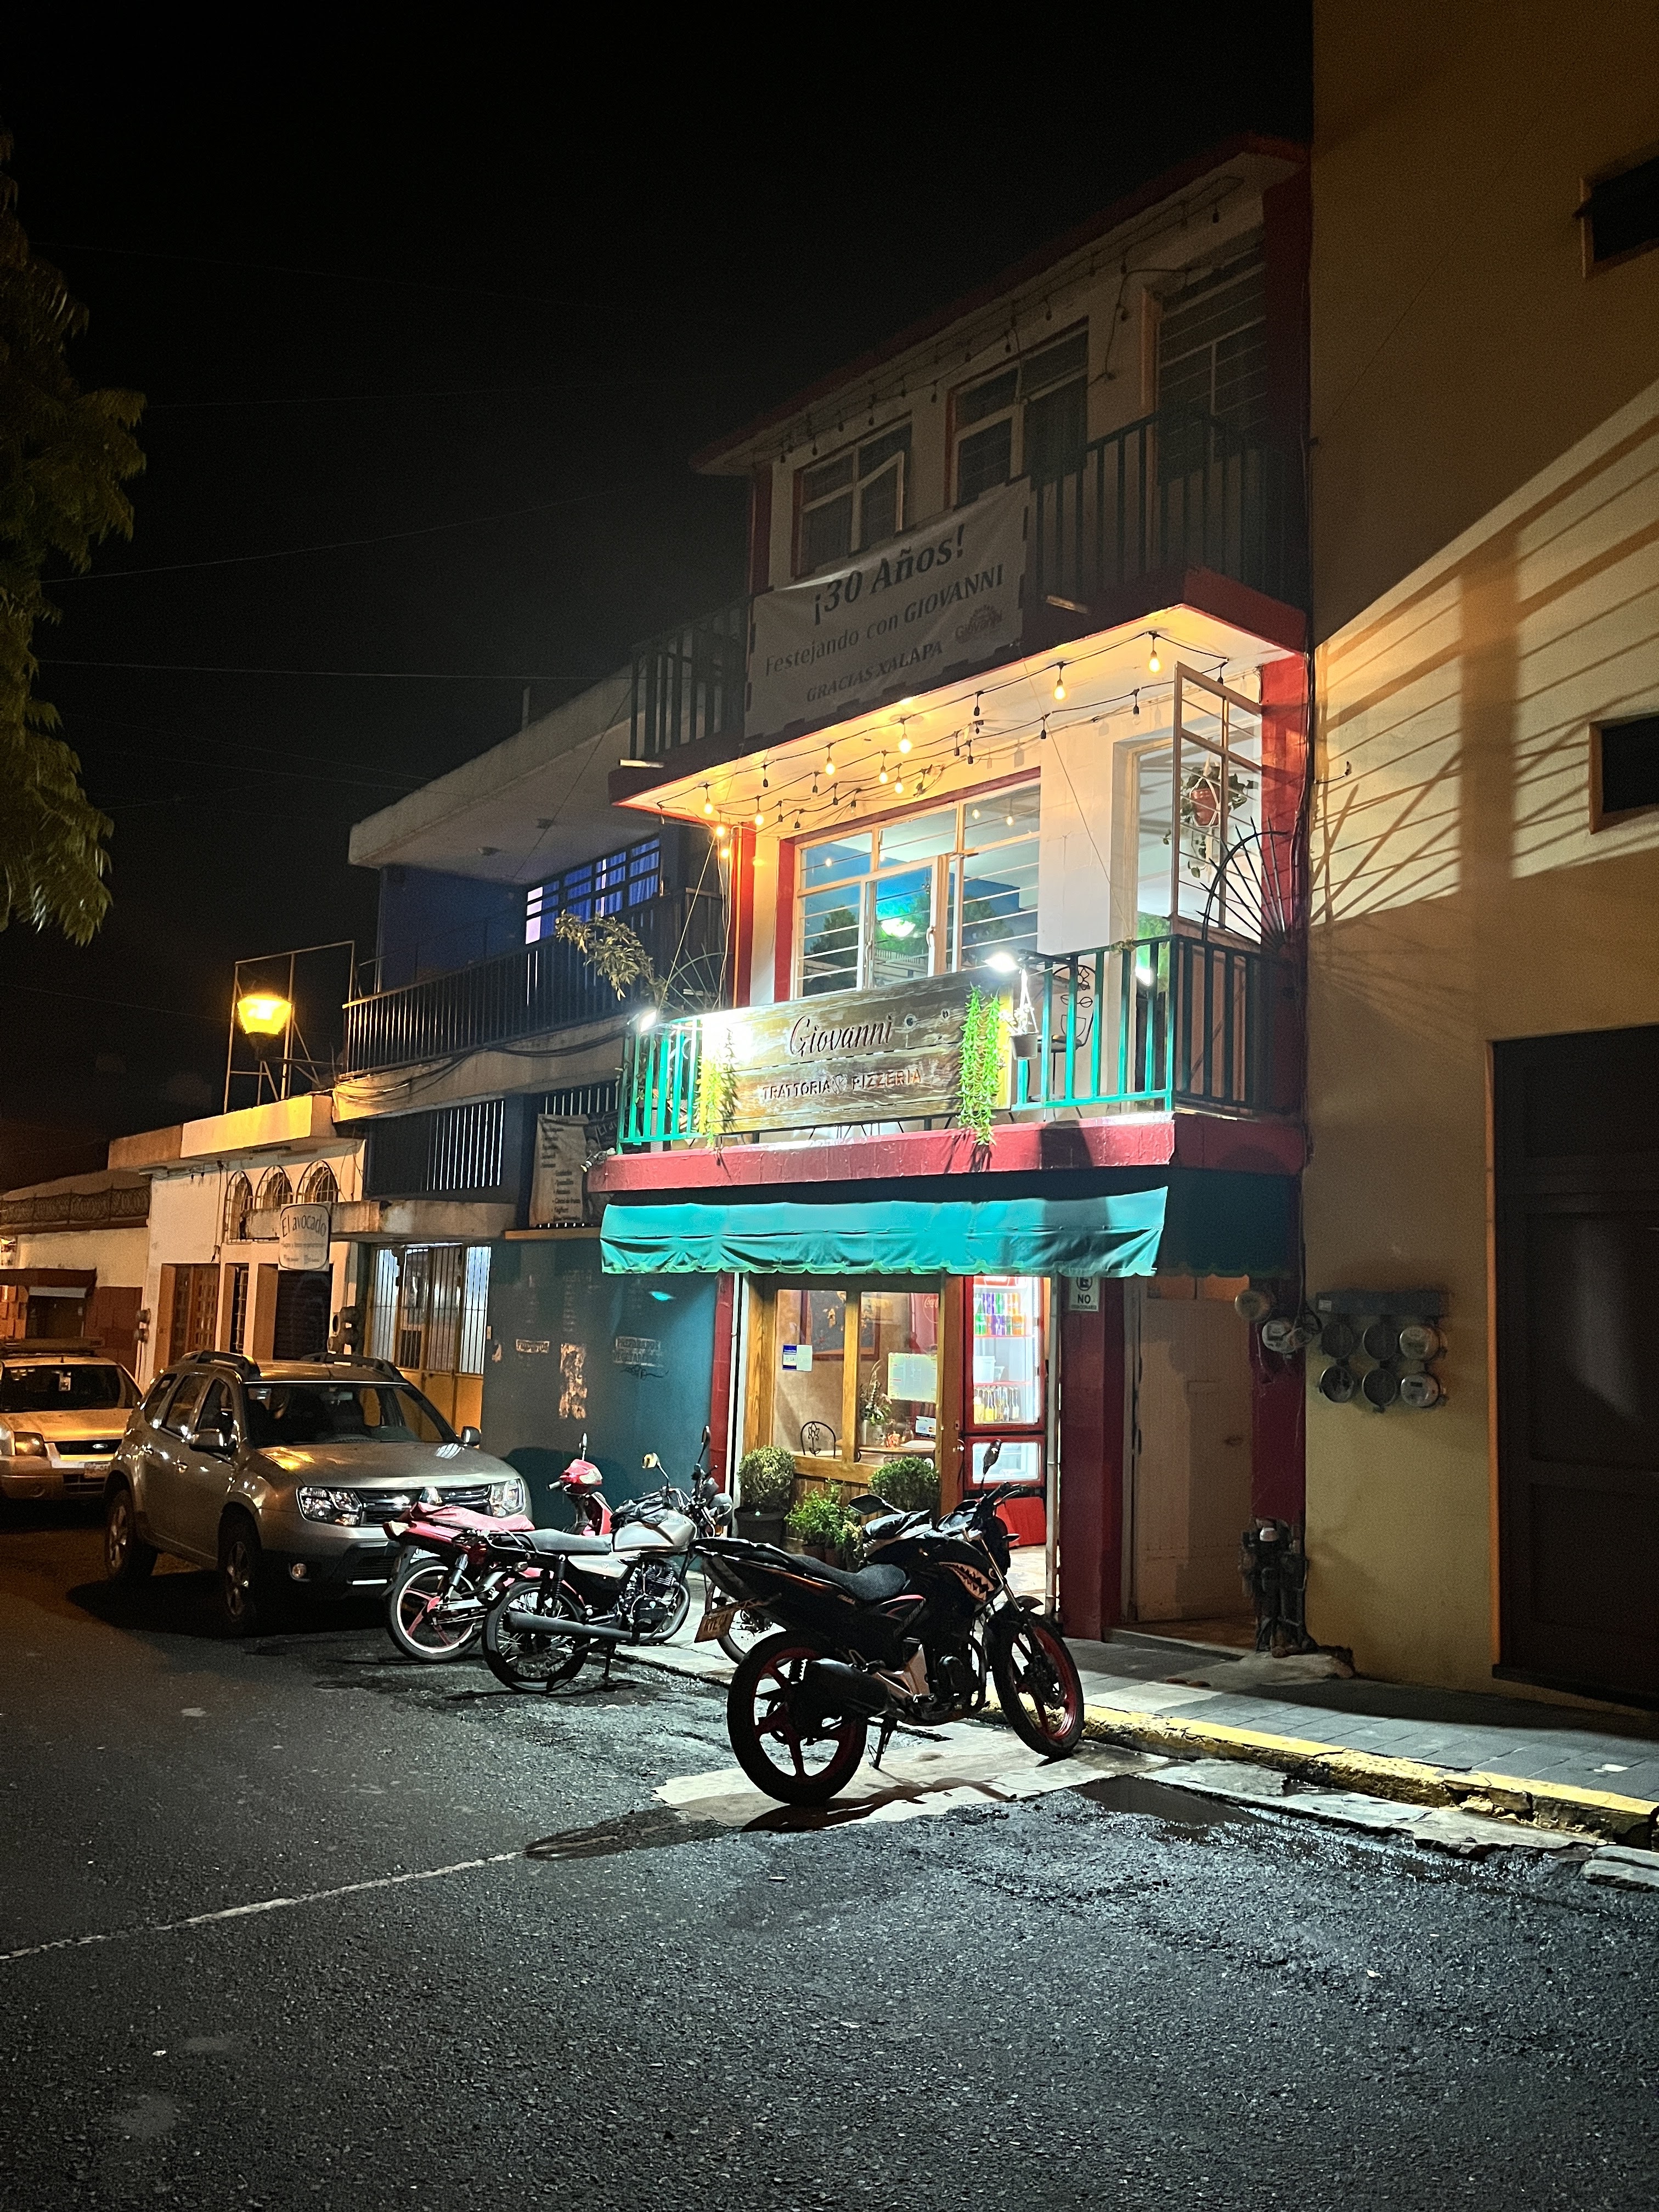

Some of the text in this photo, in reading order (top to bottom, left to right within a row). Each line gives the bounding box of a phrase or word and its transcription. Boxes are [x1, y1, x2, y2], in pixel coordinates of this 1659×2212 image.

[814, 524, 965, 625] ¡30 Años!
[766, 563, 1004, 676] Festejando con GIOVANNI
[806, 640, 944, 703] GRACIAS XALAPA
[789, 1013, 894, 1057] Giovanni
[762, 1069, 922, 1100] TRATTORIA PIZZERIA
[282, 1215, 326, 1238] El avocado
[1077, 1294, 1091, 1304] NO
